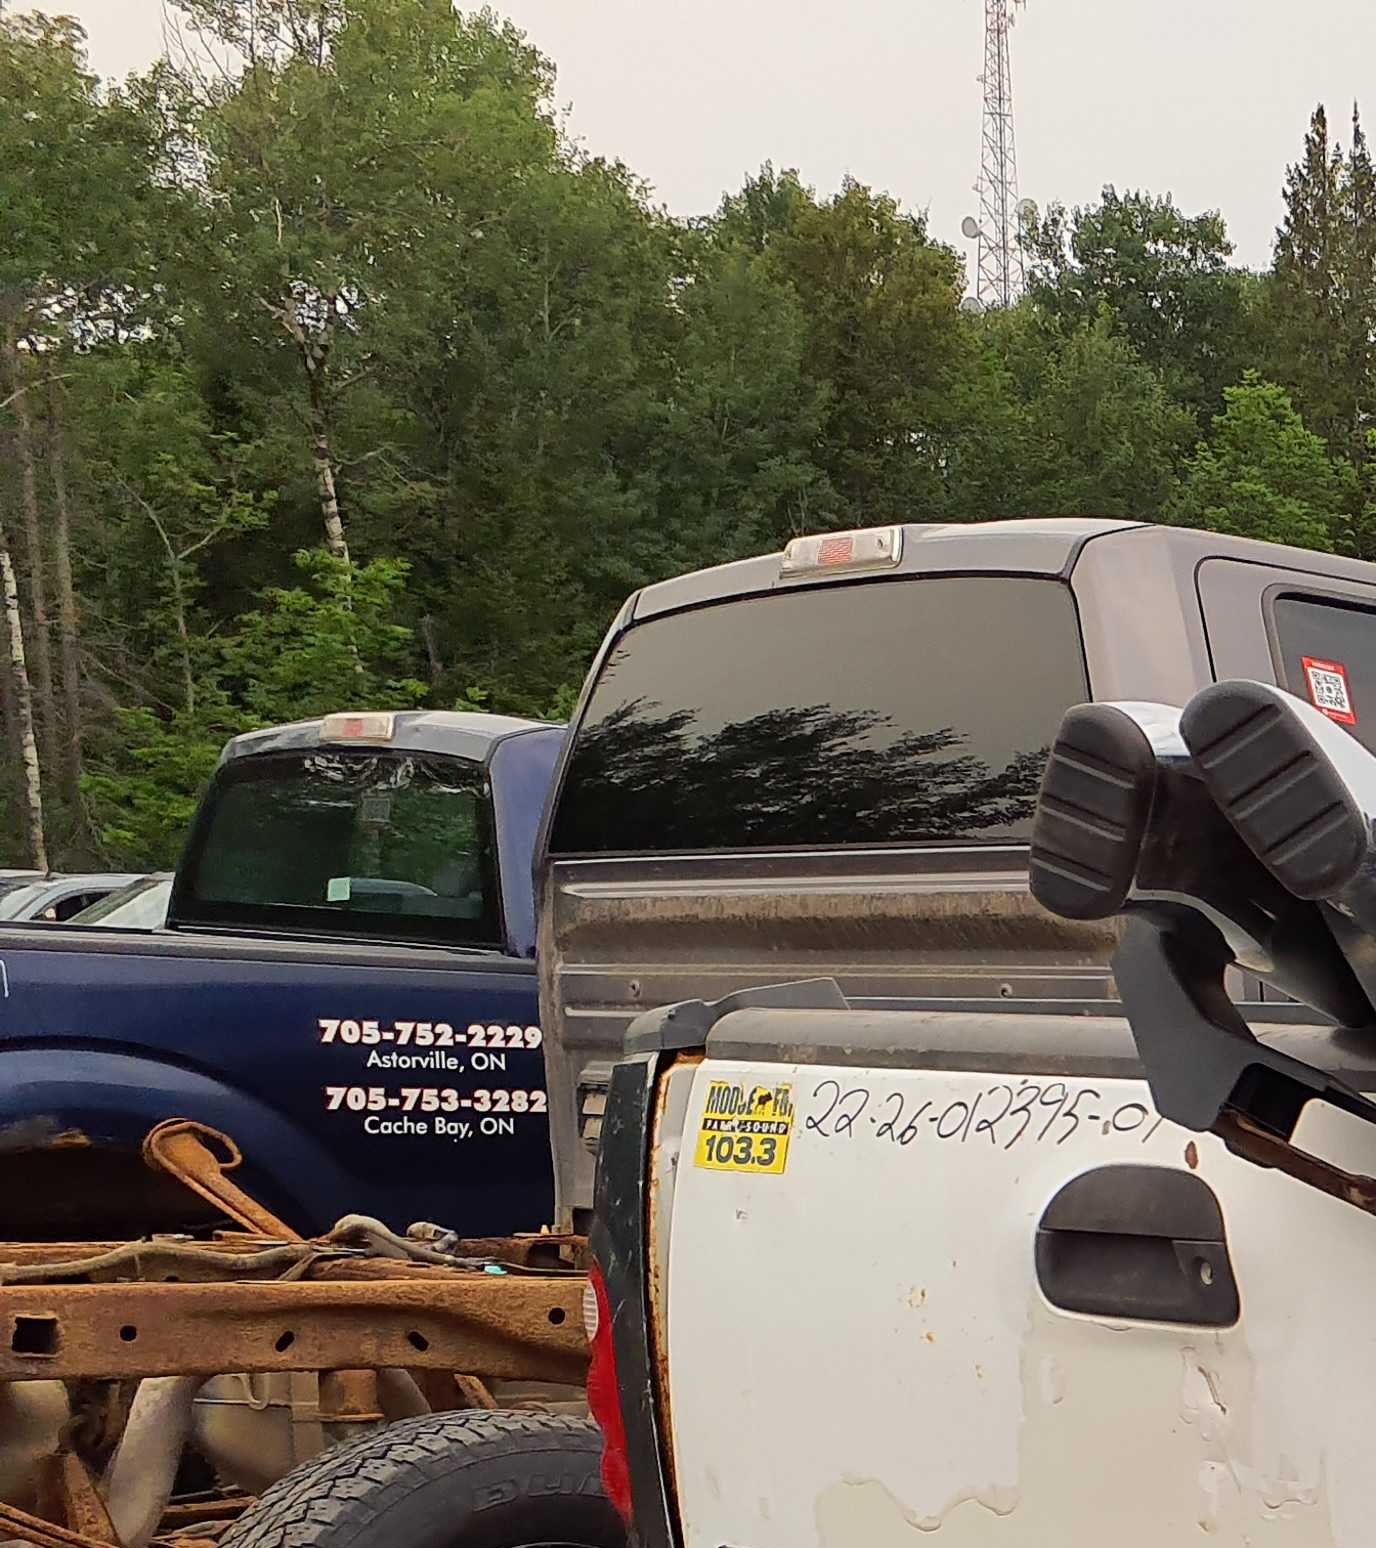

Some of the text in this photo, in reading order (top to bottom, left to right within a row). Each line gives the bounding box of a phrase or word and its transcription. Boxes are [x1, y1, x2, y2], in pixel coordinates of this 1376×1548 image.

[318, 1019, 543, 1049] 705-752-2229
[366, 1050, 506, 1072] Astorville, ON
[325, 1087, 548, 1113] 705-753-3282
[364, 1117, 515, 1139] Cache Bay, ON
[706, 1135, 777, 1166] 103.3
